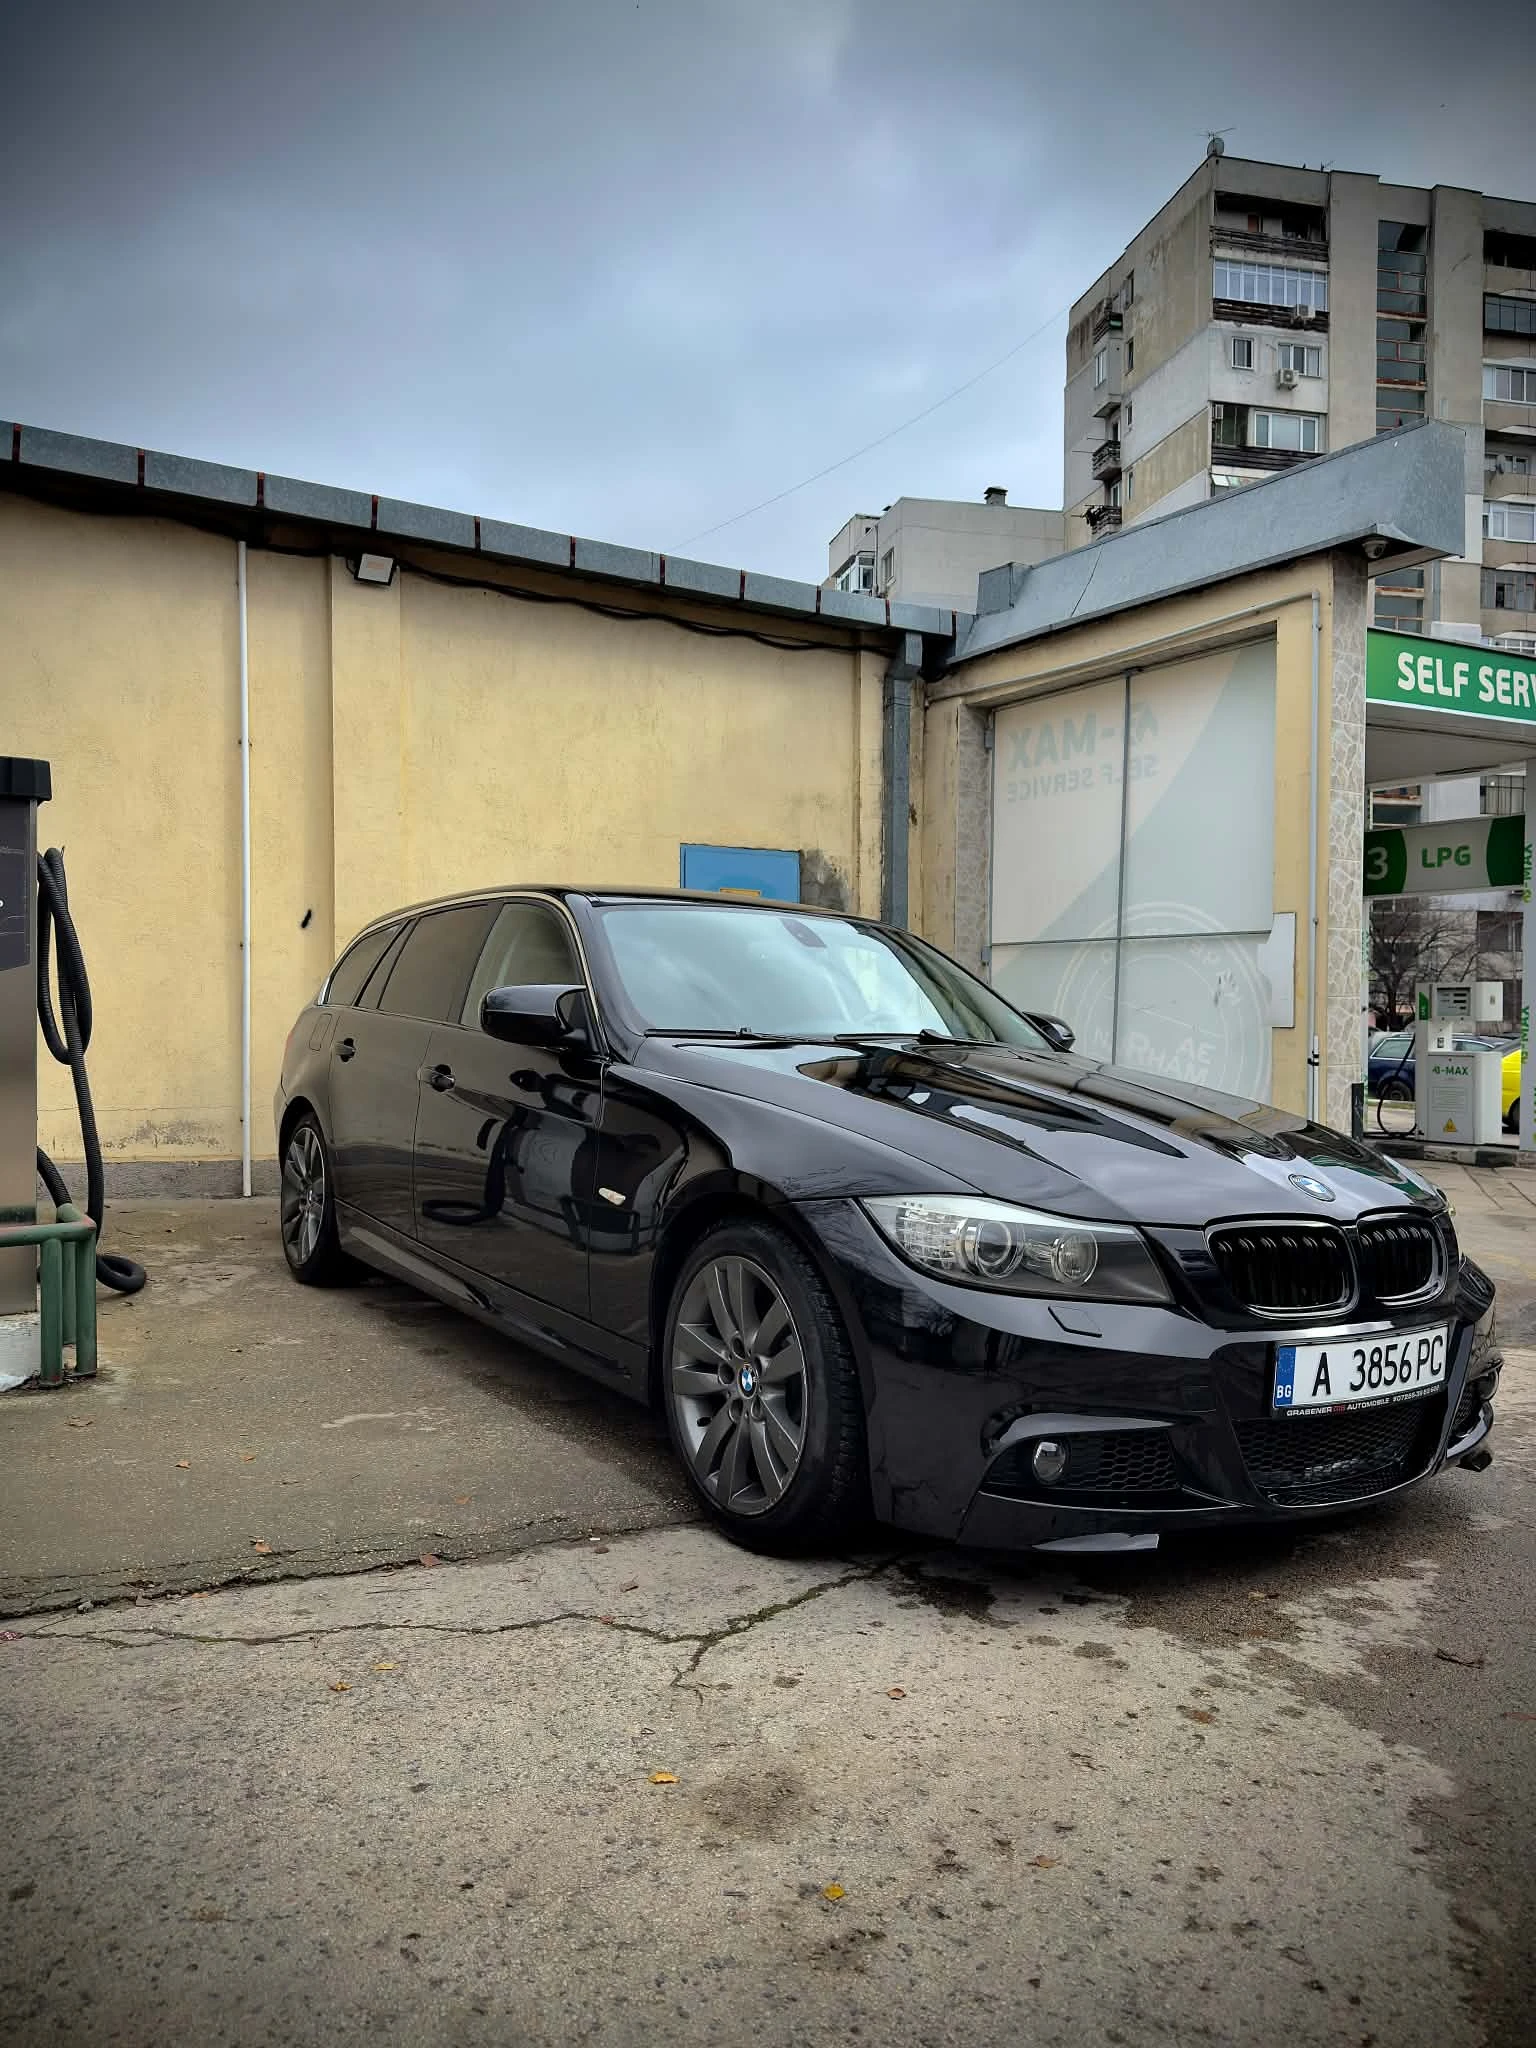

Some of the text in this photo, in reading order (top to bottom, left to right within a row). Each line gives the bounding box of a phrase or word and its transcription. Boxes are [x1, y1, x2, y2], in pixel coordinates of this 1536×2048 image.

[1397, 652, 1469, 698] SELF
[1367, 845, 1471, 881] 3 LPG
[1312, 1335, 1443, 1397] A 3856 PC
[1276, 1384, 1292, 1399] BG
[1347, 1397, 1390, 1411] AUTOMOBILE
